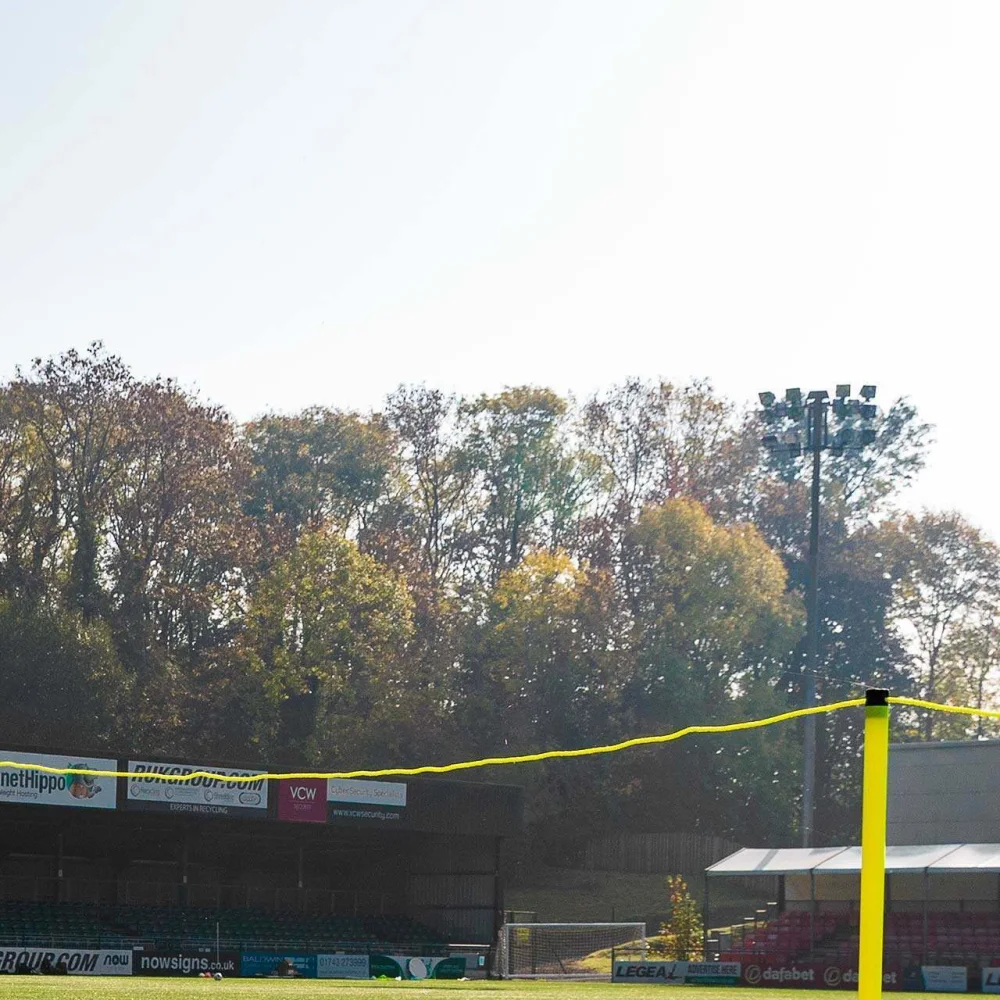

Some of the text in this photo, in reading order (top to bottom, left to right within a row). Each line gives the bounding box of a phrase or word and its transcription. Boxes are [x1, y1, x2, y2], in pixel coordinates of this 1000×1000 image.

[16, 791, 38, 799] Hosting
[290, 786, 317, 800] VCW
[170, 803, 192, 812] EXPERTS
[200, 805, 228, 814] RECYCLING
[103, 954, 129, 965] now
[141, 954, 234, 973] nowsigns.co.uk
[763, 967, 815, 983] dafabet
[842, 969, 898, 984] daet
